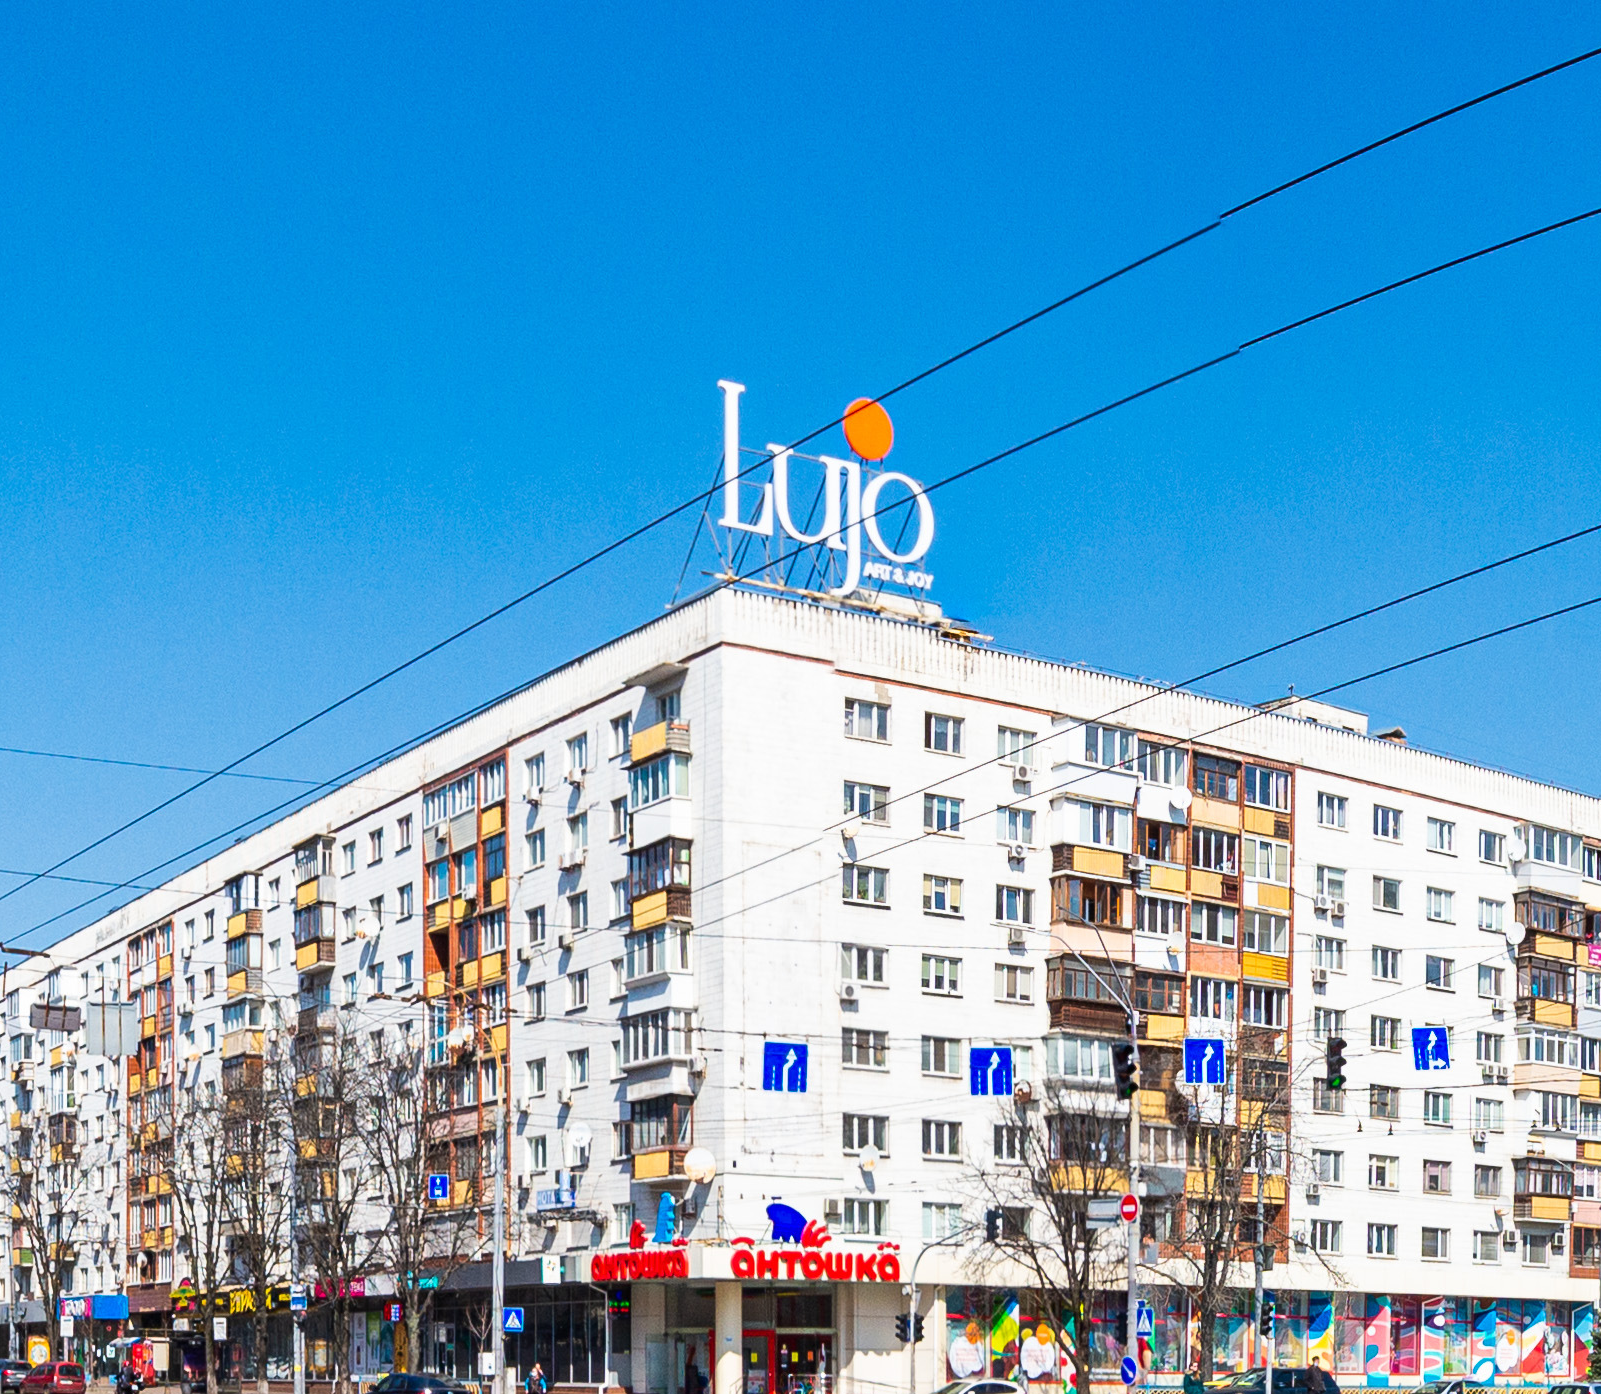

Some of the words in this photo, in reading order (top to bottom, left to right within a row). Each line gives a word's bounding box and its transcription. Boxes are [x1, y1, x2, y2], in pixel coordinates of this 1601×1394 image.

[717, 379, 935, 597] Lujo
[863, 561, 891, 581] ART
[906, 569, 934, 590] JOY
